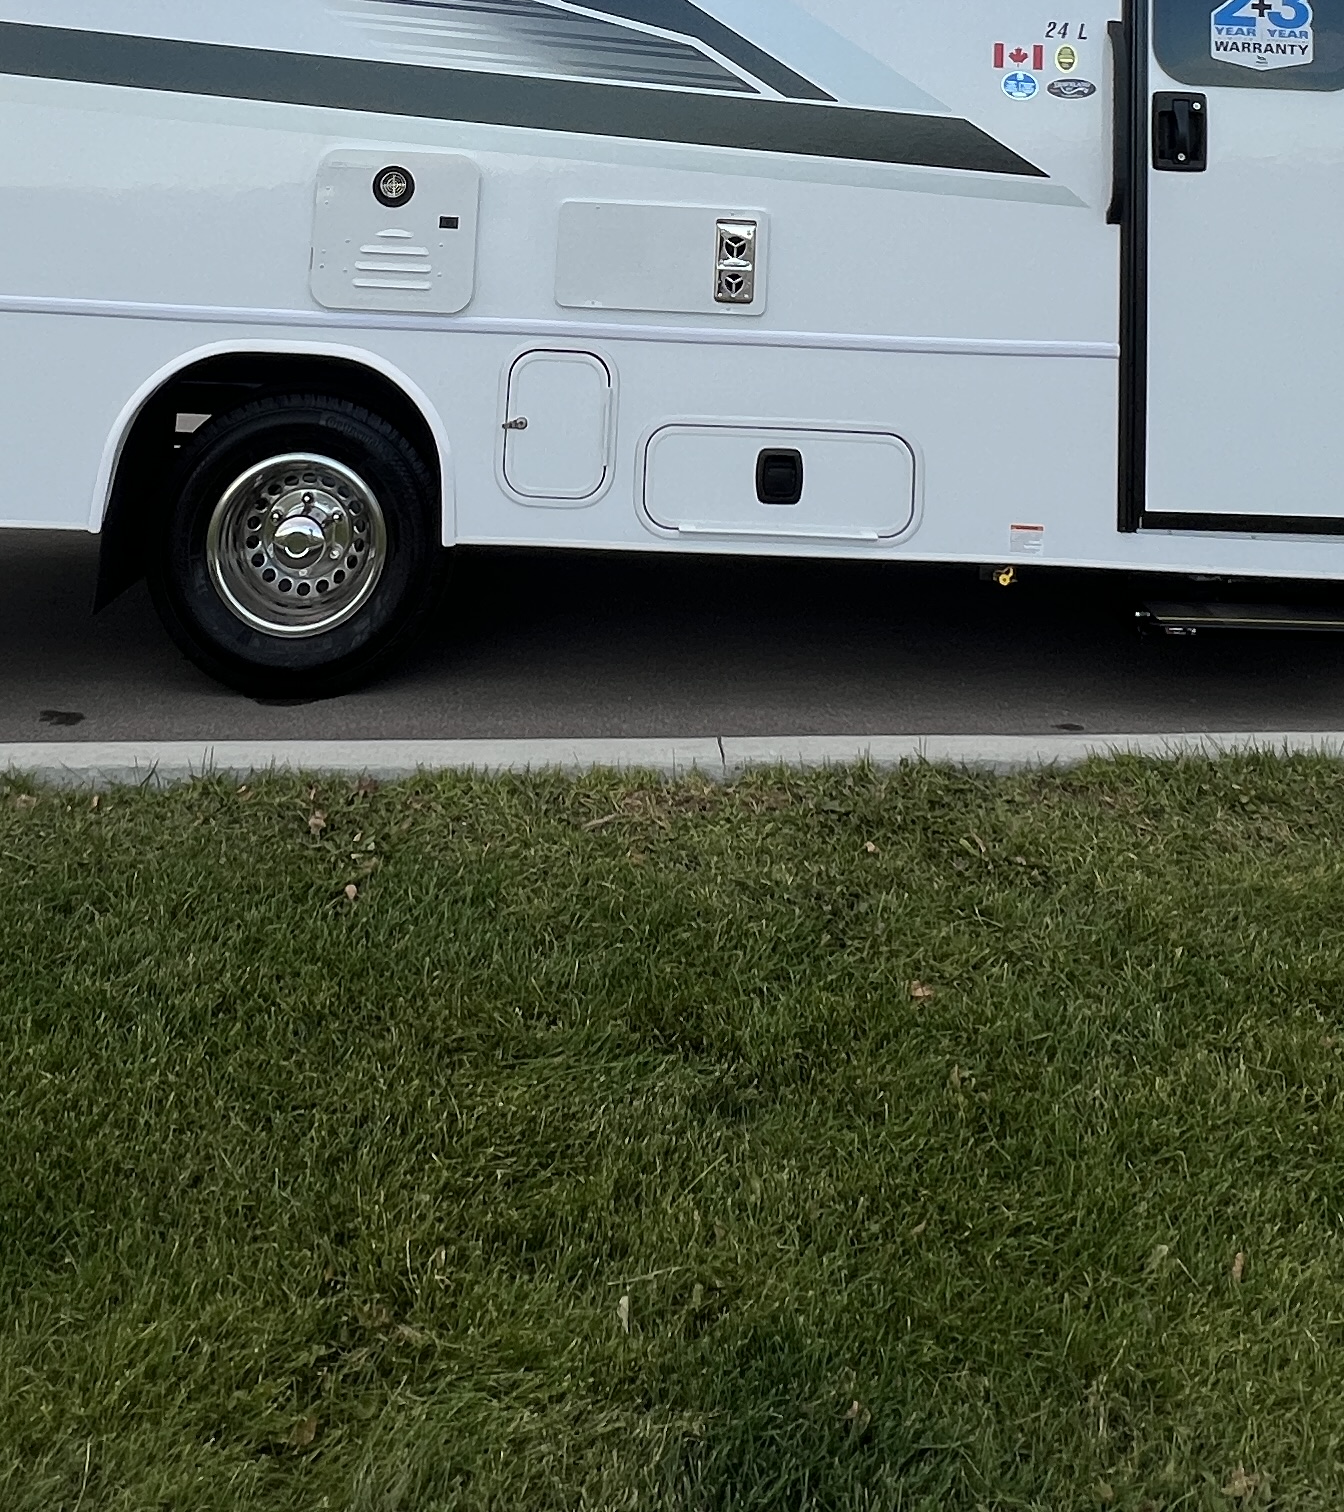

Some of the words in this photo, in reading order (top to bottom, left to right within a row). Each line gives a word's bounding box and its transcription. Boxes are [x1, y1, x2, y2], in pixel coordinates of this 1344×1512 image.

[1045, 21, 1069, 39] 24
[1077, 23, 1088, 40] L
[1215, 26, 1256, 37] YEAR
[1267, 28, 1309, 40] YEAR
[1215, 40, 1309, 56] WARRANTY
